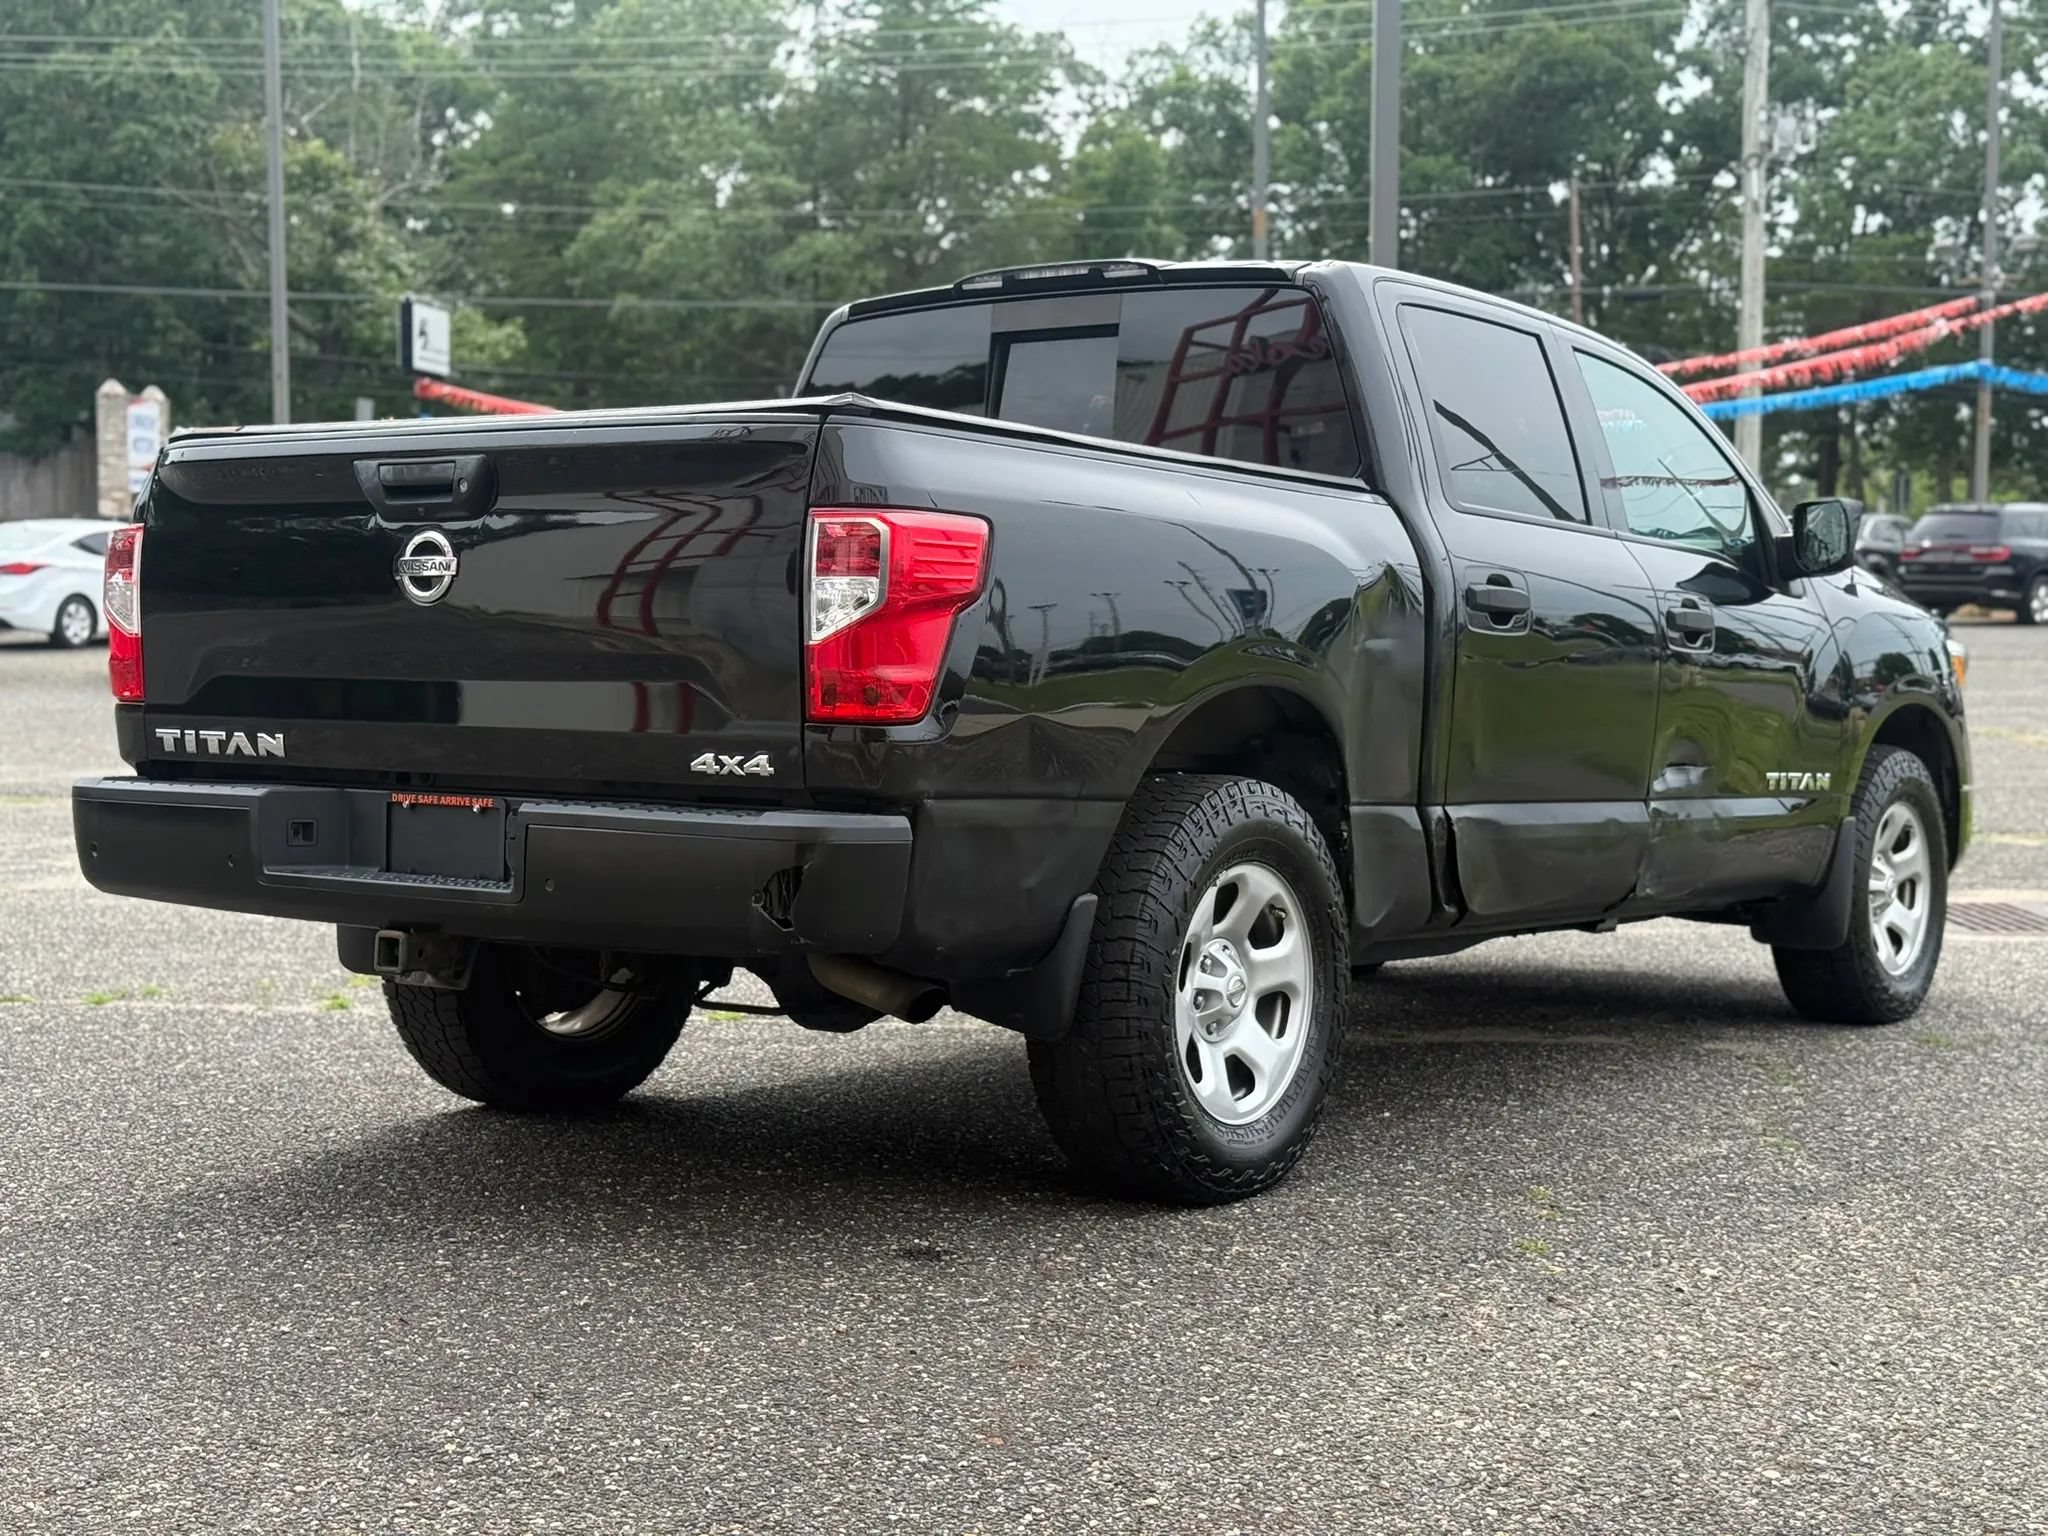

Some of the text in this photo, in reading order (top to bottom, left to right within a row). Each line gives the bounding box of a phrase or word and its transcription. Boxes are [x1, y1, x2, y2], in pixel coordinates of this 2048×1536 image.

[401, 559, 451, 573] NISSAN
[155, 728, 286, 758] TITAN
[1766, 772, 1831, 791] TITAN
[391, 793, 493, 807] DRIVE SAFE ARRIVE SAFE
